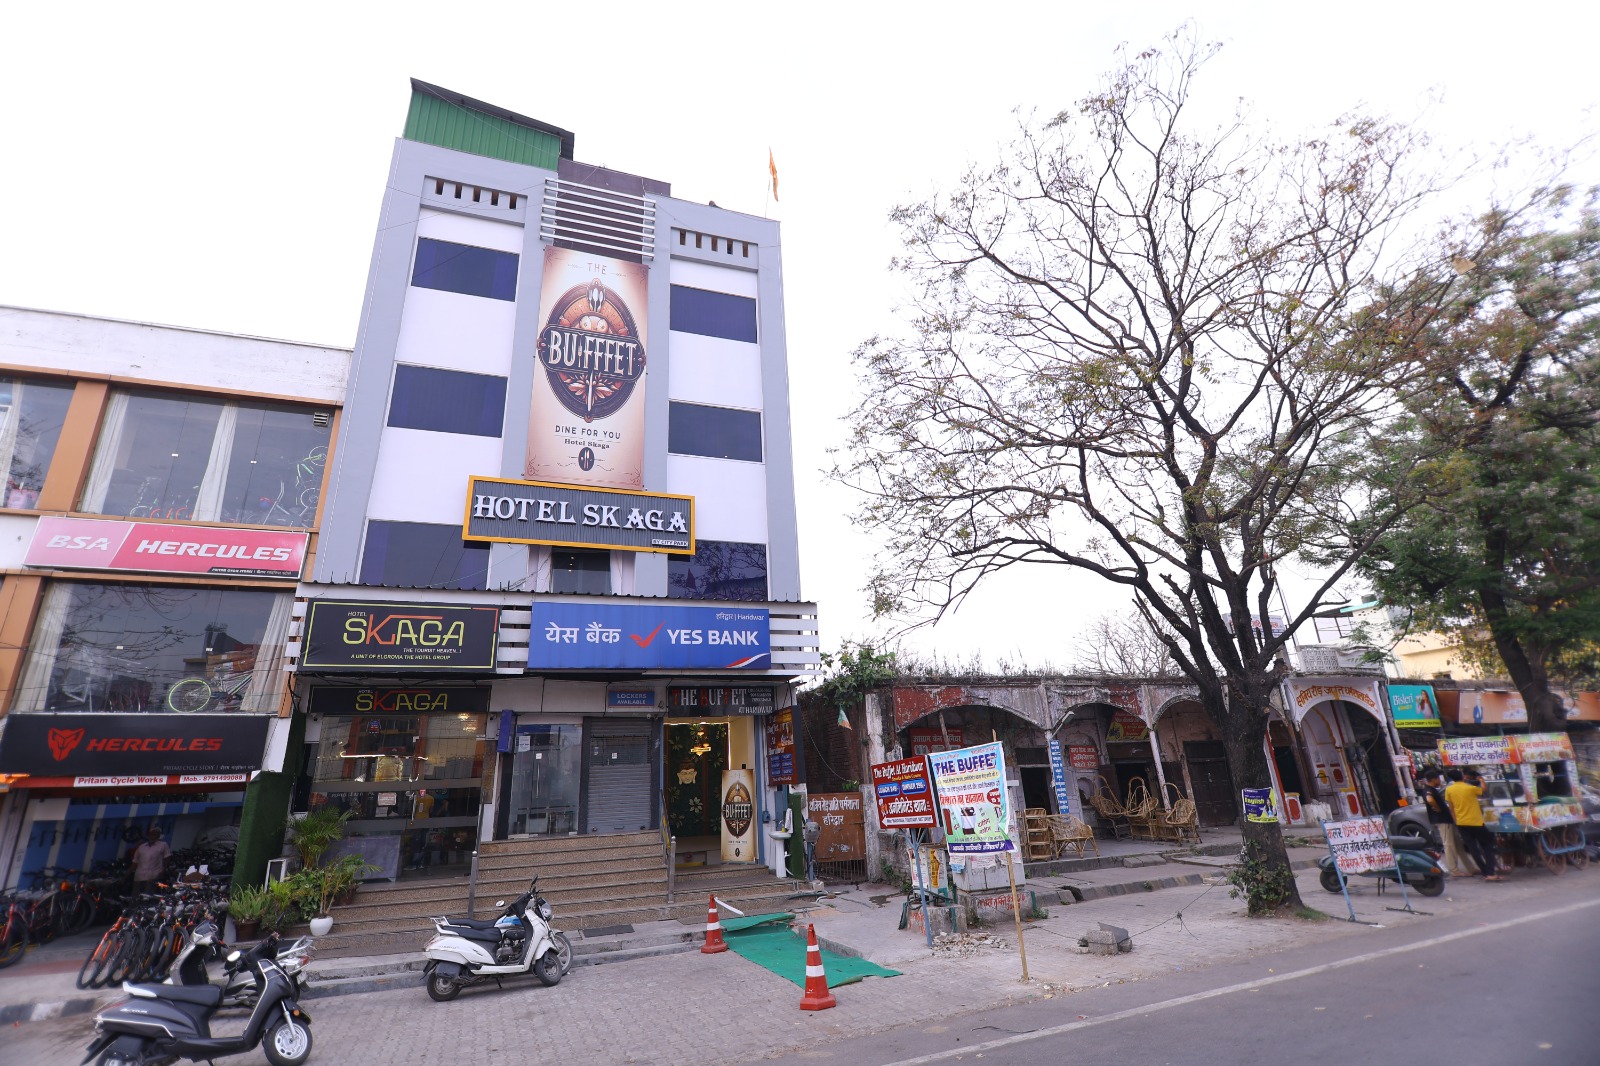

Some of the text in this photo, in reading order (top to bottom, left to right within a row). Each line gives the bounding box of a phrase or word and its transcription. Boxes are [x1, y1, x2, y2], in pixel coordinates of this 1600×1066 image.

[587, 262, 607, 275] THE
[555, 425, 621, 440] DINE FOR YOU
[564, 438, 610, 450] Hotel Skaga
[473, 494, 688, 534] HOTEL SKAGA
[46, 534, 293, 561] BSA HERCULES
[716, 611, 733, 621] हरिद्वार
[737, 613, 764, 621] Haridwar
[343, 614, 465, 647] SKAGA
[544, 620, 622, 644] येस बैंक
[667, 629, 759, 646] YES BANK
[355, 690, 448, 711] SKAGA
[672, 688, 747, 707] THE BUFFET
[1392, 693, 1413, 707] Bisleri
[86, 738, 224, 751] HERCULES
[1460, 739, 1474, 751] भाई
[934, 752, 997, 776] THE BUFFET
[78, 776, 164, 786] Pritam Cycle Works
